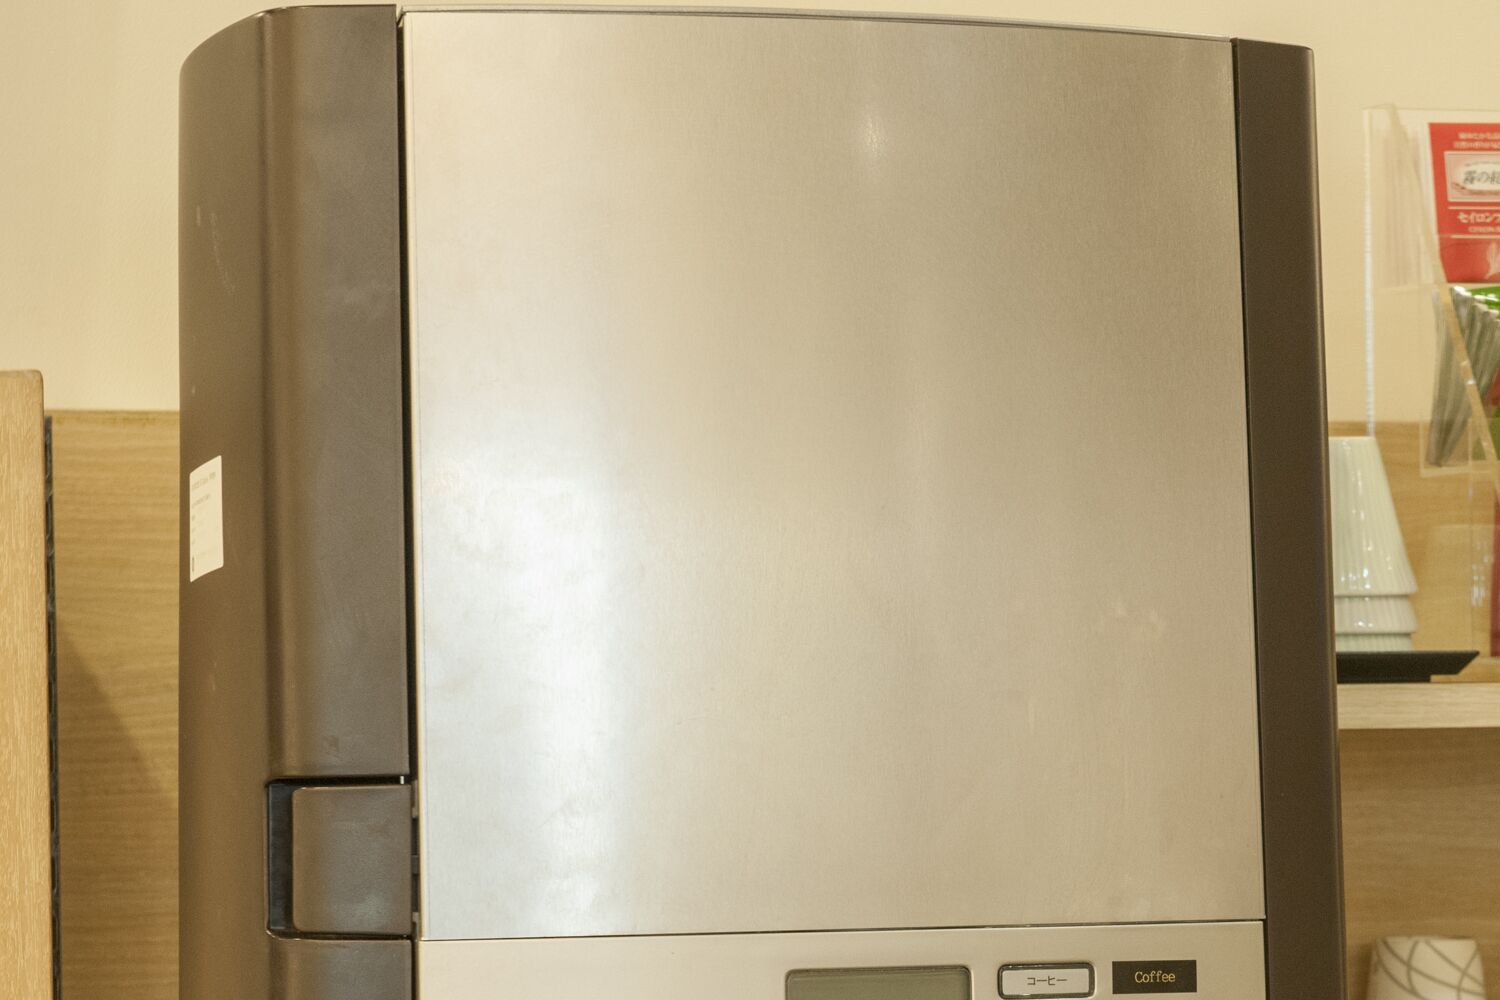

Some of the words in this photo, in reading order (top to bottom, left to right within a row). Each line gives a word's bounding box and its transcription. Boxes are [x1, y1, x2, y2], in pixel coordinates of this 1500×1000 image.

[1026, 976, 1068, 986] コーヒー
[1134, 971, 1176, 984] Coffee
